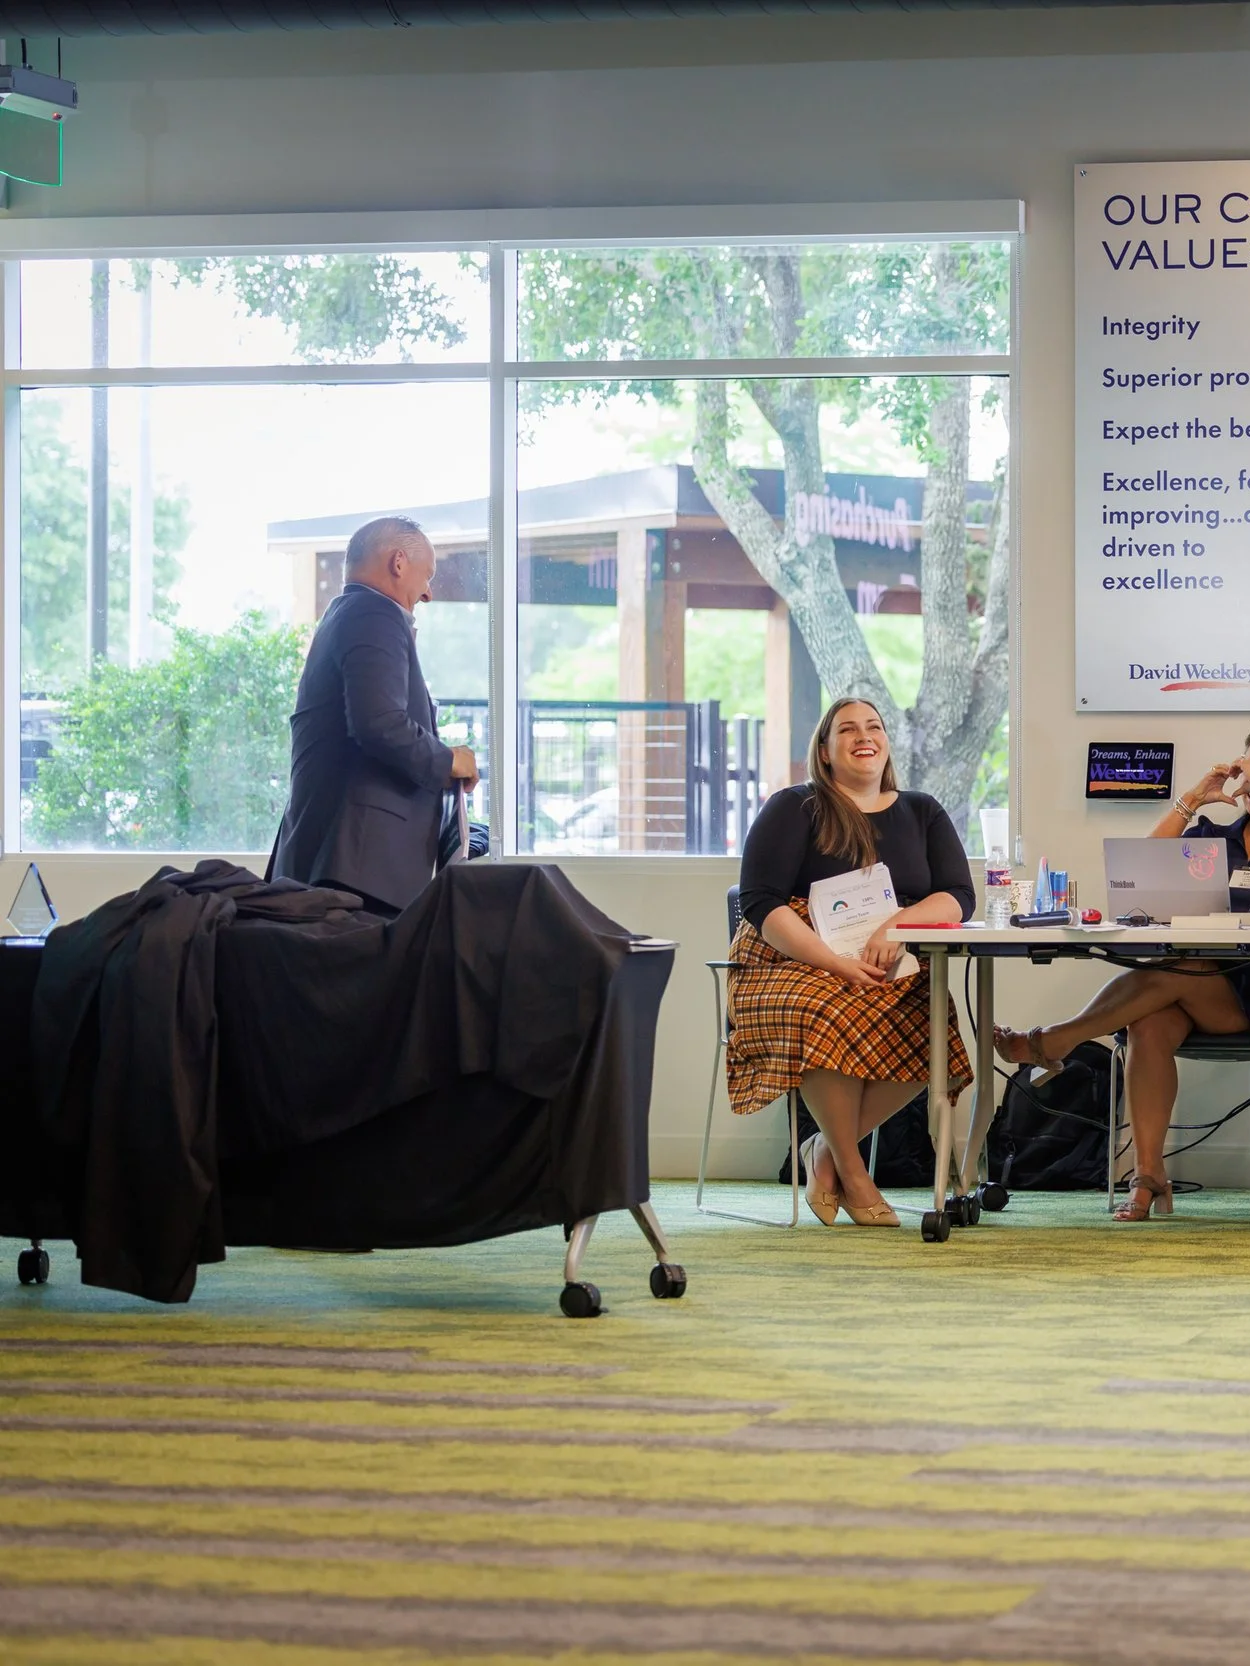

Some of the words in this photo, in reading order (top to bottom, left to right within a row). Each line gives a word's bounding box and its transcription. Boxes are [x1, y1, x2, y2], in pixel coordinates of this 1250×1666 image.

[1104, 194, 1202, 226] OUR
[1102, 315, 1201, 341] Integrity
[1102, 367, 1203, 393] Superior
[1102, 420, 1180, 446] Expect
[1185, 418, 1222, 439] the
[1102, 470, 1231, 494] Excellence,
[1102, 536, 1176, 558] driven
[1182, 539, 1207, 558] to
[1102, 568, 1225, 591] excellence
[1128, 663, 1181, 681] David
[1089, 762, 1165, 784] Weekley
